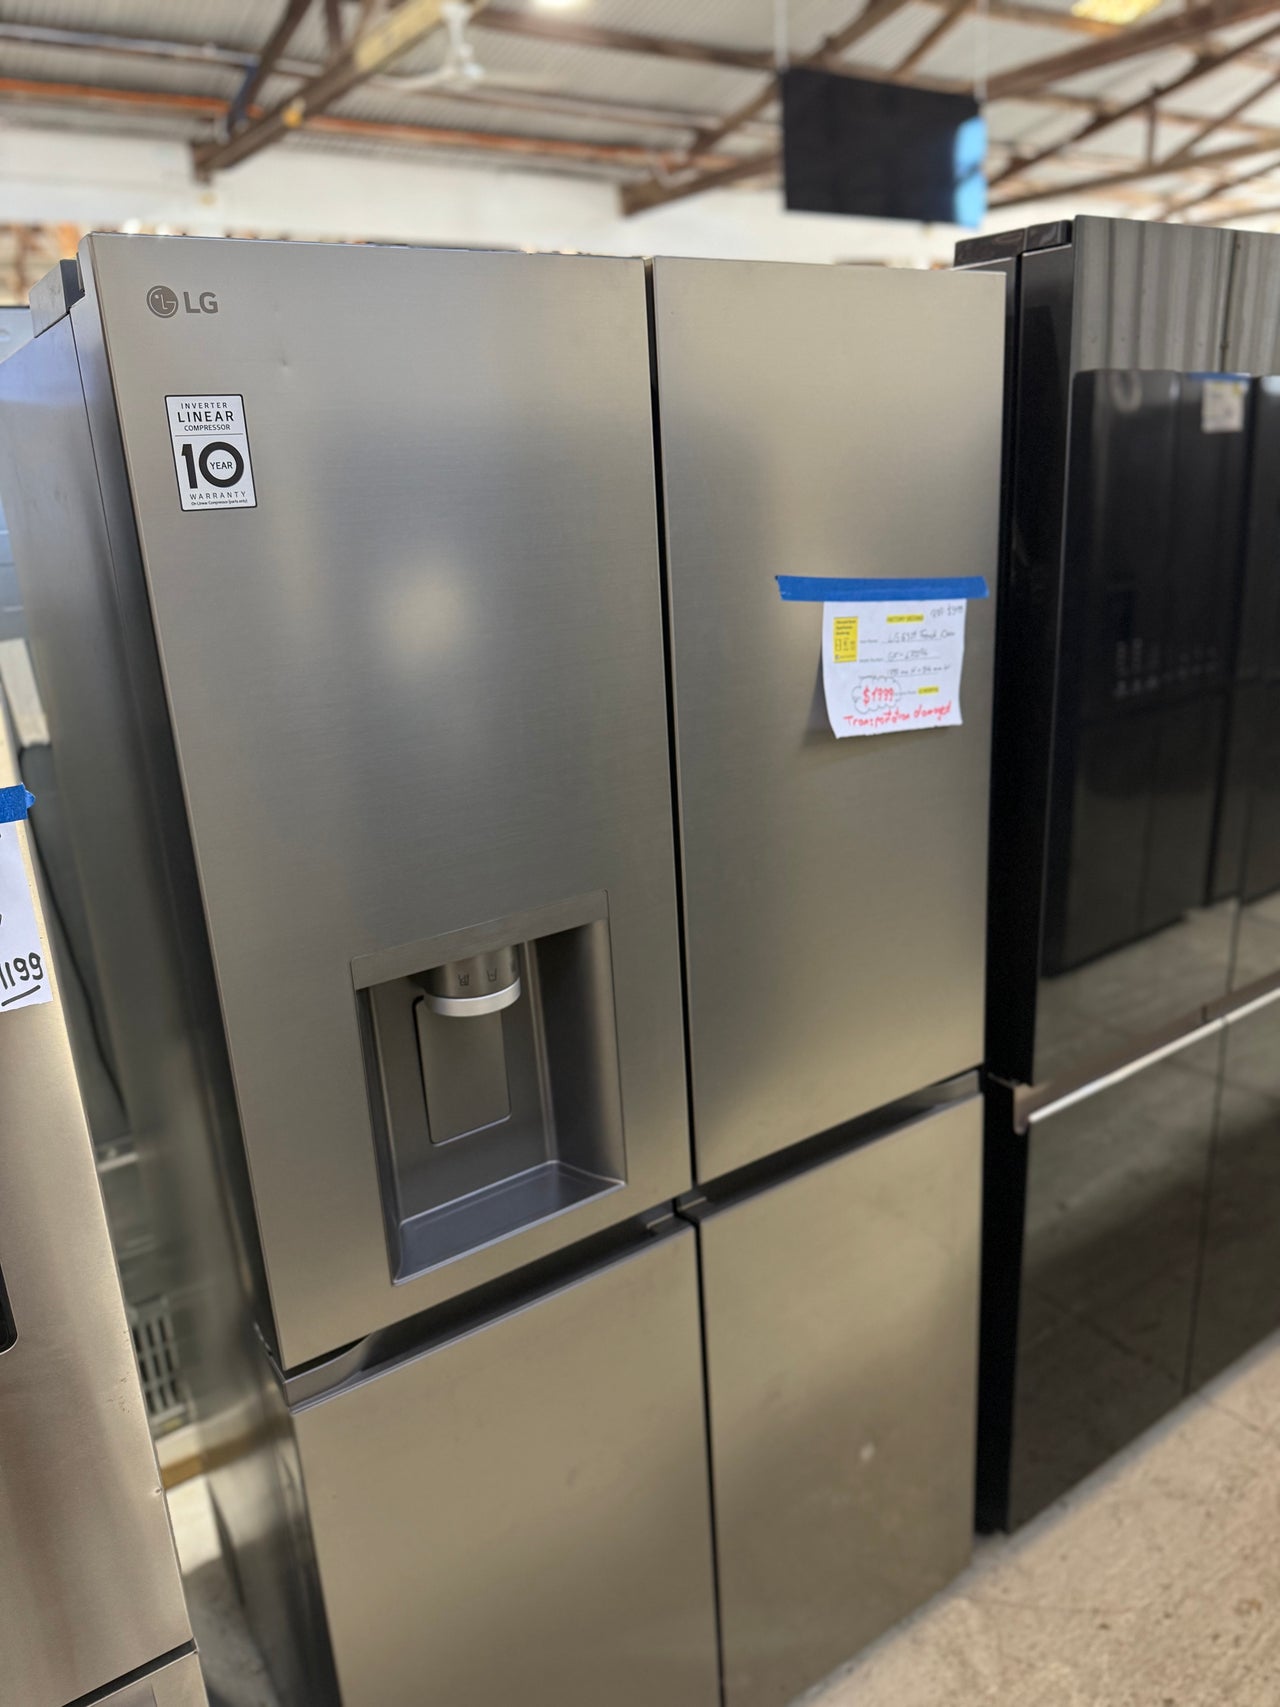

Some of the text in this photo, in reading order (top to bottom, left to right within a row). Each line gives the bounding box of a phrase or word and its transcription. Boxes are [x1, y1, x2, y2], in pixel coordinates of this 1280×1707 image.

[183, 291, 219, 314] LG
[177, 410, 234, 423] LINEAR
[181, 441, 245, 490] 10
[209, 461, 233, 470] YEAR
[189, 491, 246, 500] WARRANTY
